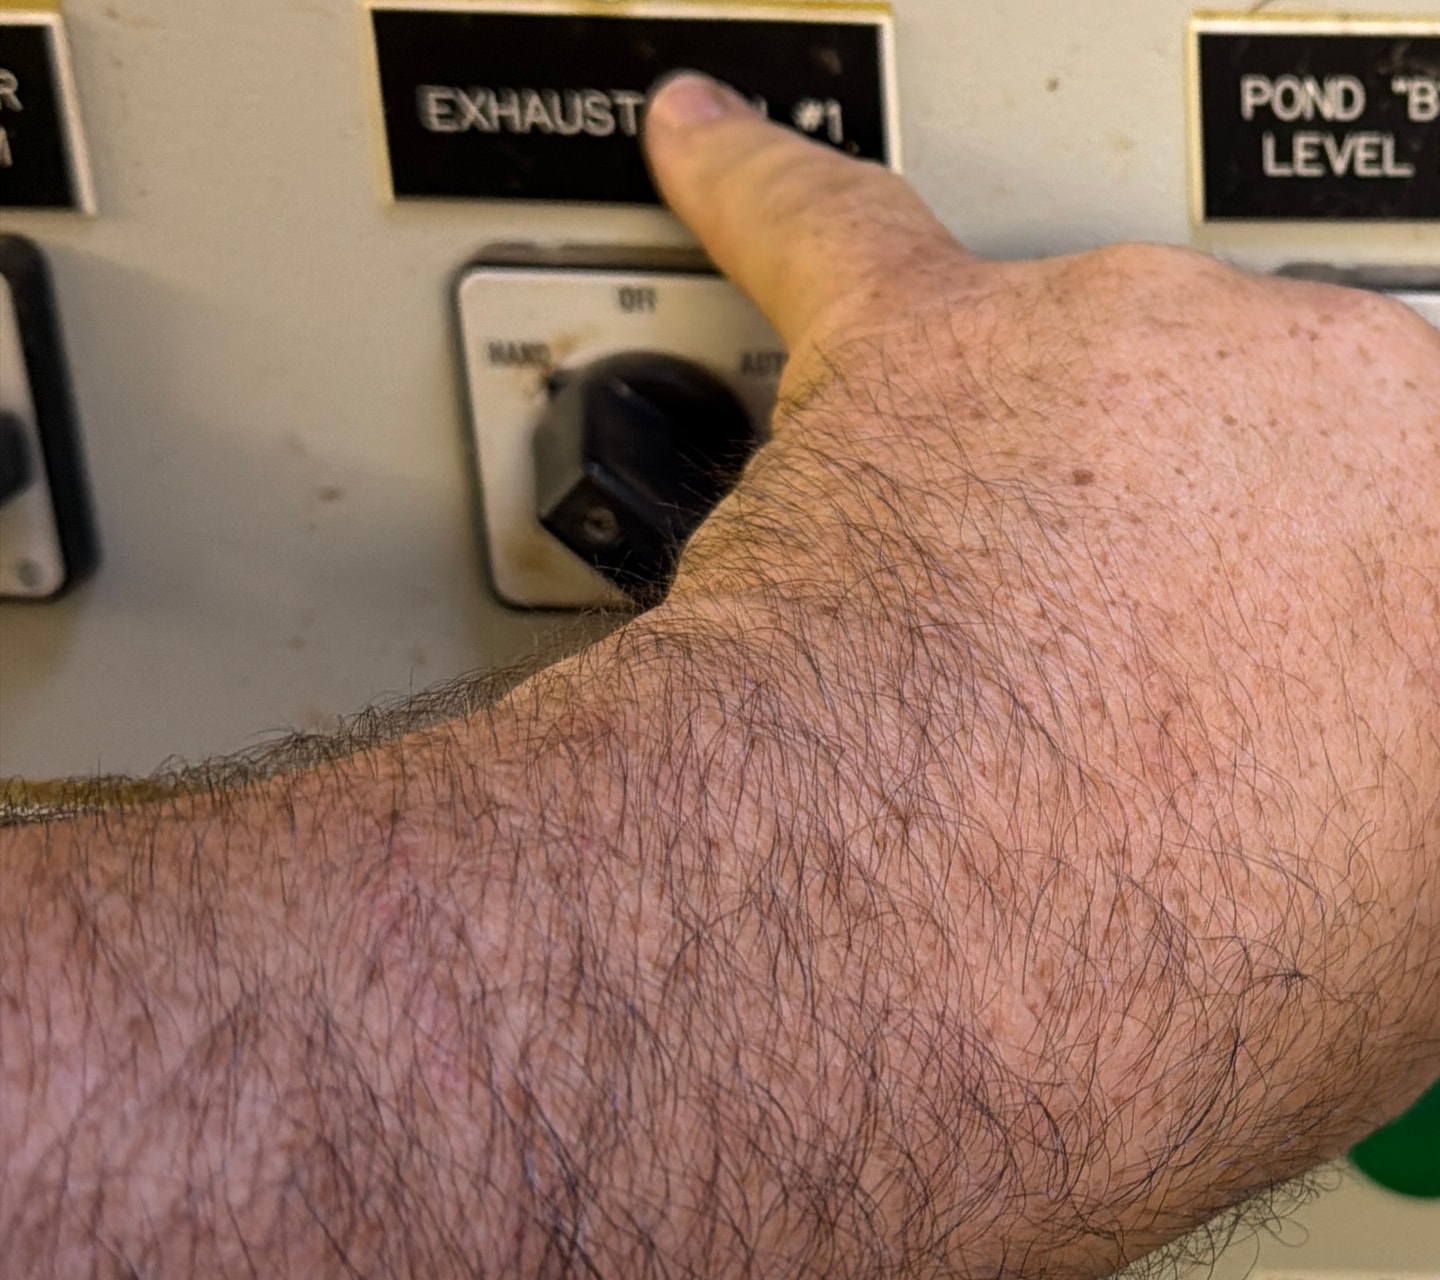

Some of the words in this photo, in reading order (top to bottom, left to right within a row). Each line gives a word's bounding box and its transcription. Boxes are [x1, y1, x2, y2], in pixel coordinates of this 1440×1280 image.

[418, 85, 645, 138] EXHAUST
[794, 98, 844, 144] #1
[1239, 73, 1367, 121] POND
[1262, 131, 1415, 178] LEVEL
[741, 350, 788, 377] AUT
